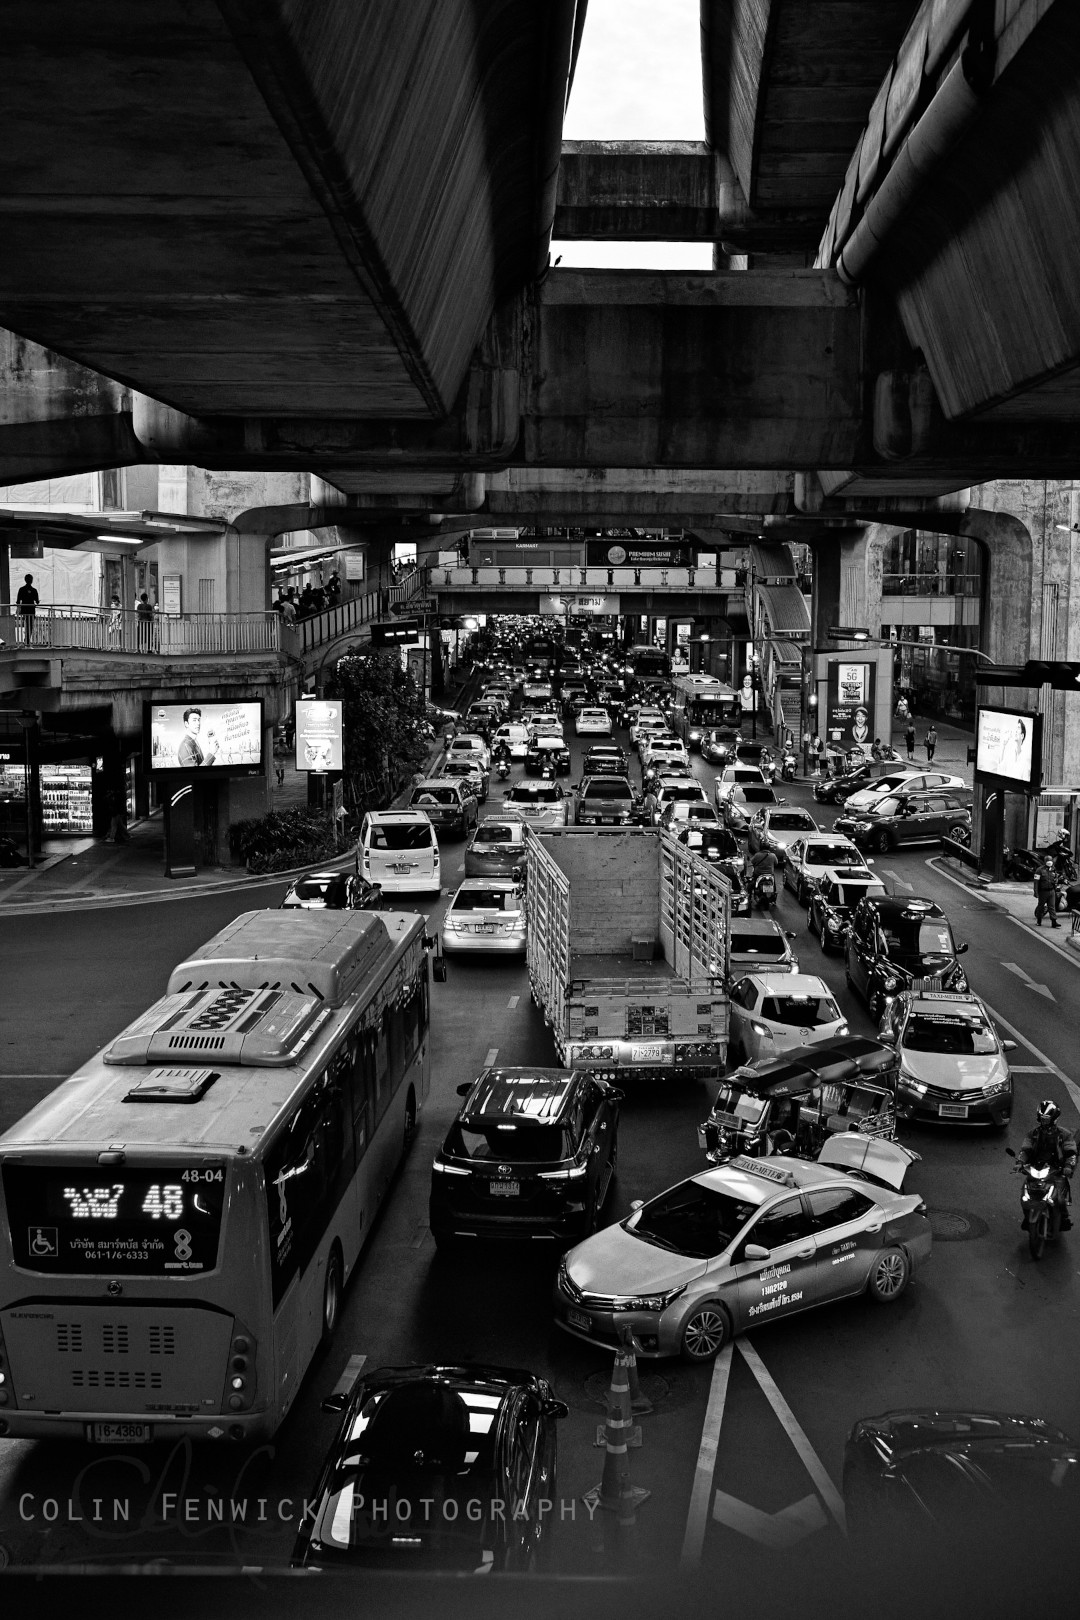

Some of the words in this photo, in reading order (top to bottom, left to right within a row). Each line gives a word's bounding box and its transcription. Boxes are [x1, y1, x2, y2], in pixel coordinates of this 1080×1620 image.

[578, 597, 601, 606] สยาม
[846, 672, 857, 681] 5G
[181, 1169, 223, 1183] 48-04
[741, 1159, 781, 1179] TAXI-METER
[142, 1184, 184, 1219] 48
[69, 1237, 95, 1249] บริษัท
[97, 1237, 139, 1249] สมาร์ทบัส
[141, 1238, 165, 1250] จำกัด
[98, 1424, 143, 1438] 16-4360
